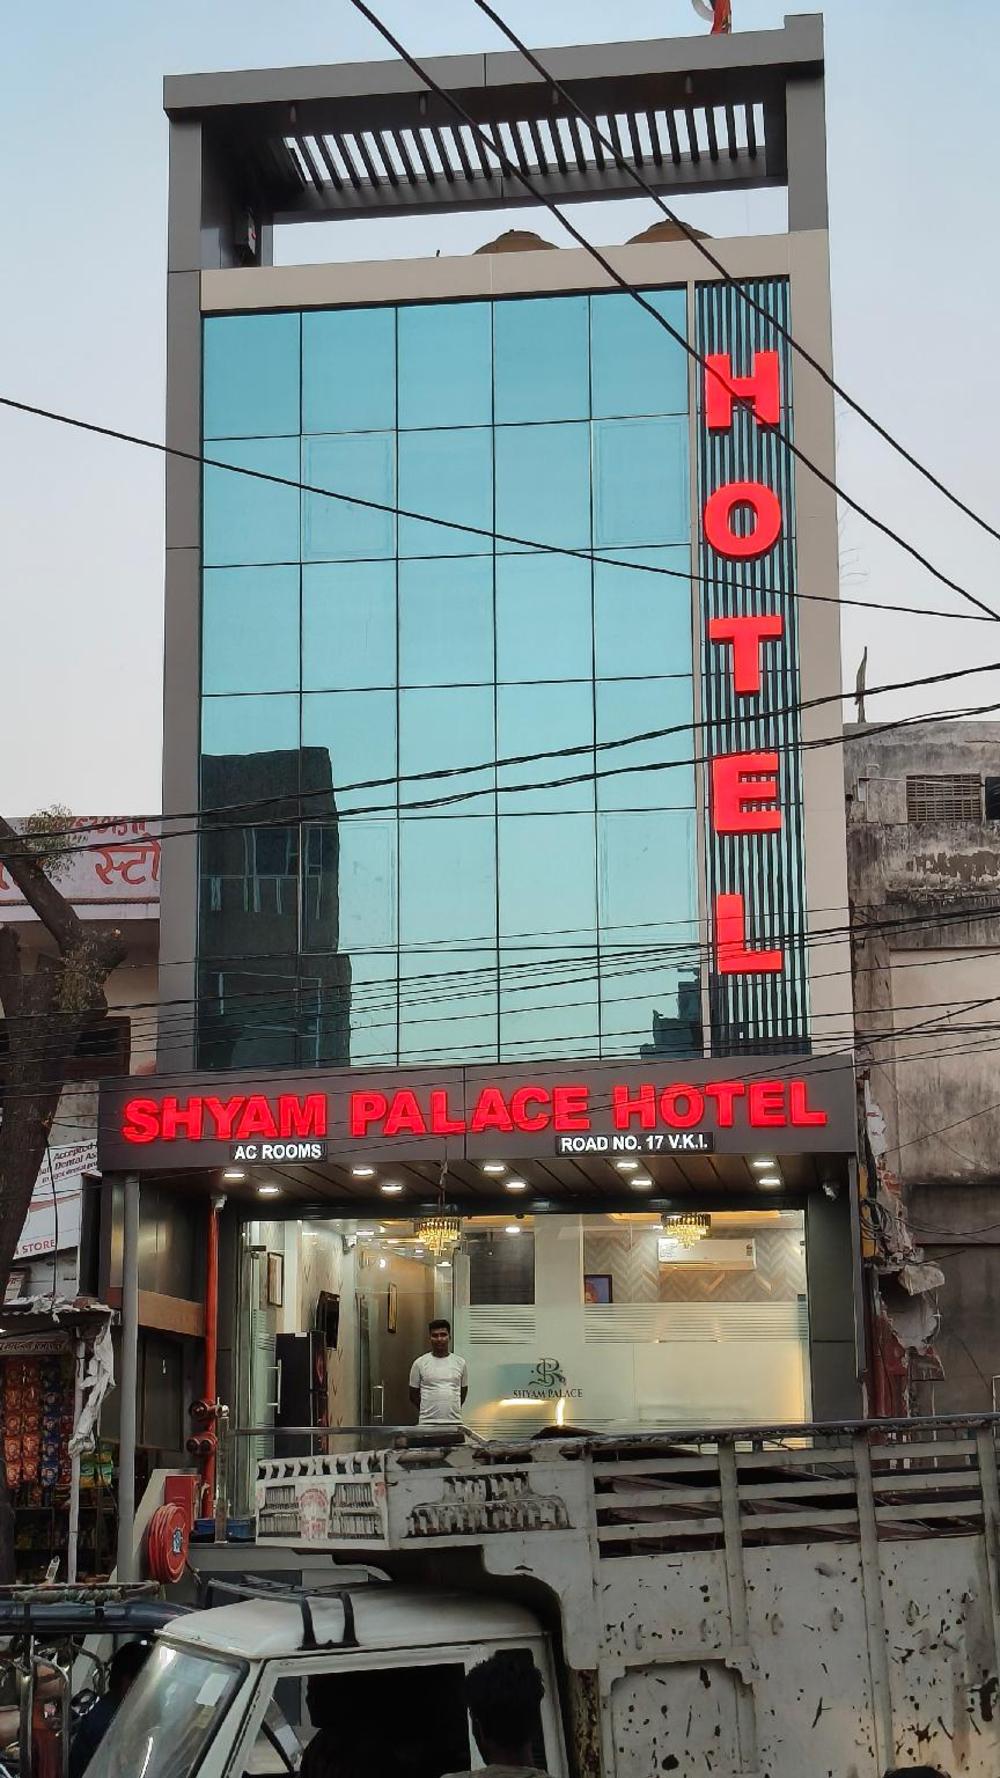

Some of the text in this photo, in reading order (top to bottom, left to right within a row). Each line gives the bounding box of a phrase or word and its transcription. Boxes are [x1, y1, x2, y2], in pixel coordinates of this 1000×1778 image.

[705, 350, 782, 974] HOTEL
[121, 1093, 328, 1144] SHYAM
[351, 1086, 590, 1137] PALACE
[612, 1080, 828, 1130] HOTEL
[234, 1143, 322, 1160] AC ROOMS
[561, 1133, 708, 1152] ROAD NO. 17 V.K.I.
[22, 1240, 55, 1254] STORE
[513, 1388, 583, 1399] SHYAM PALACE
